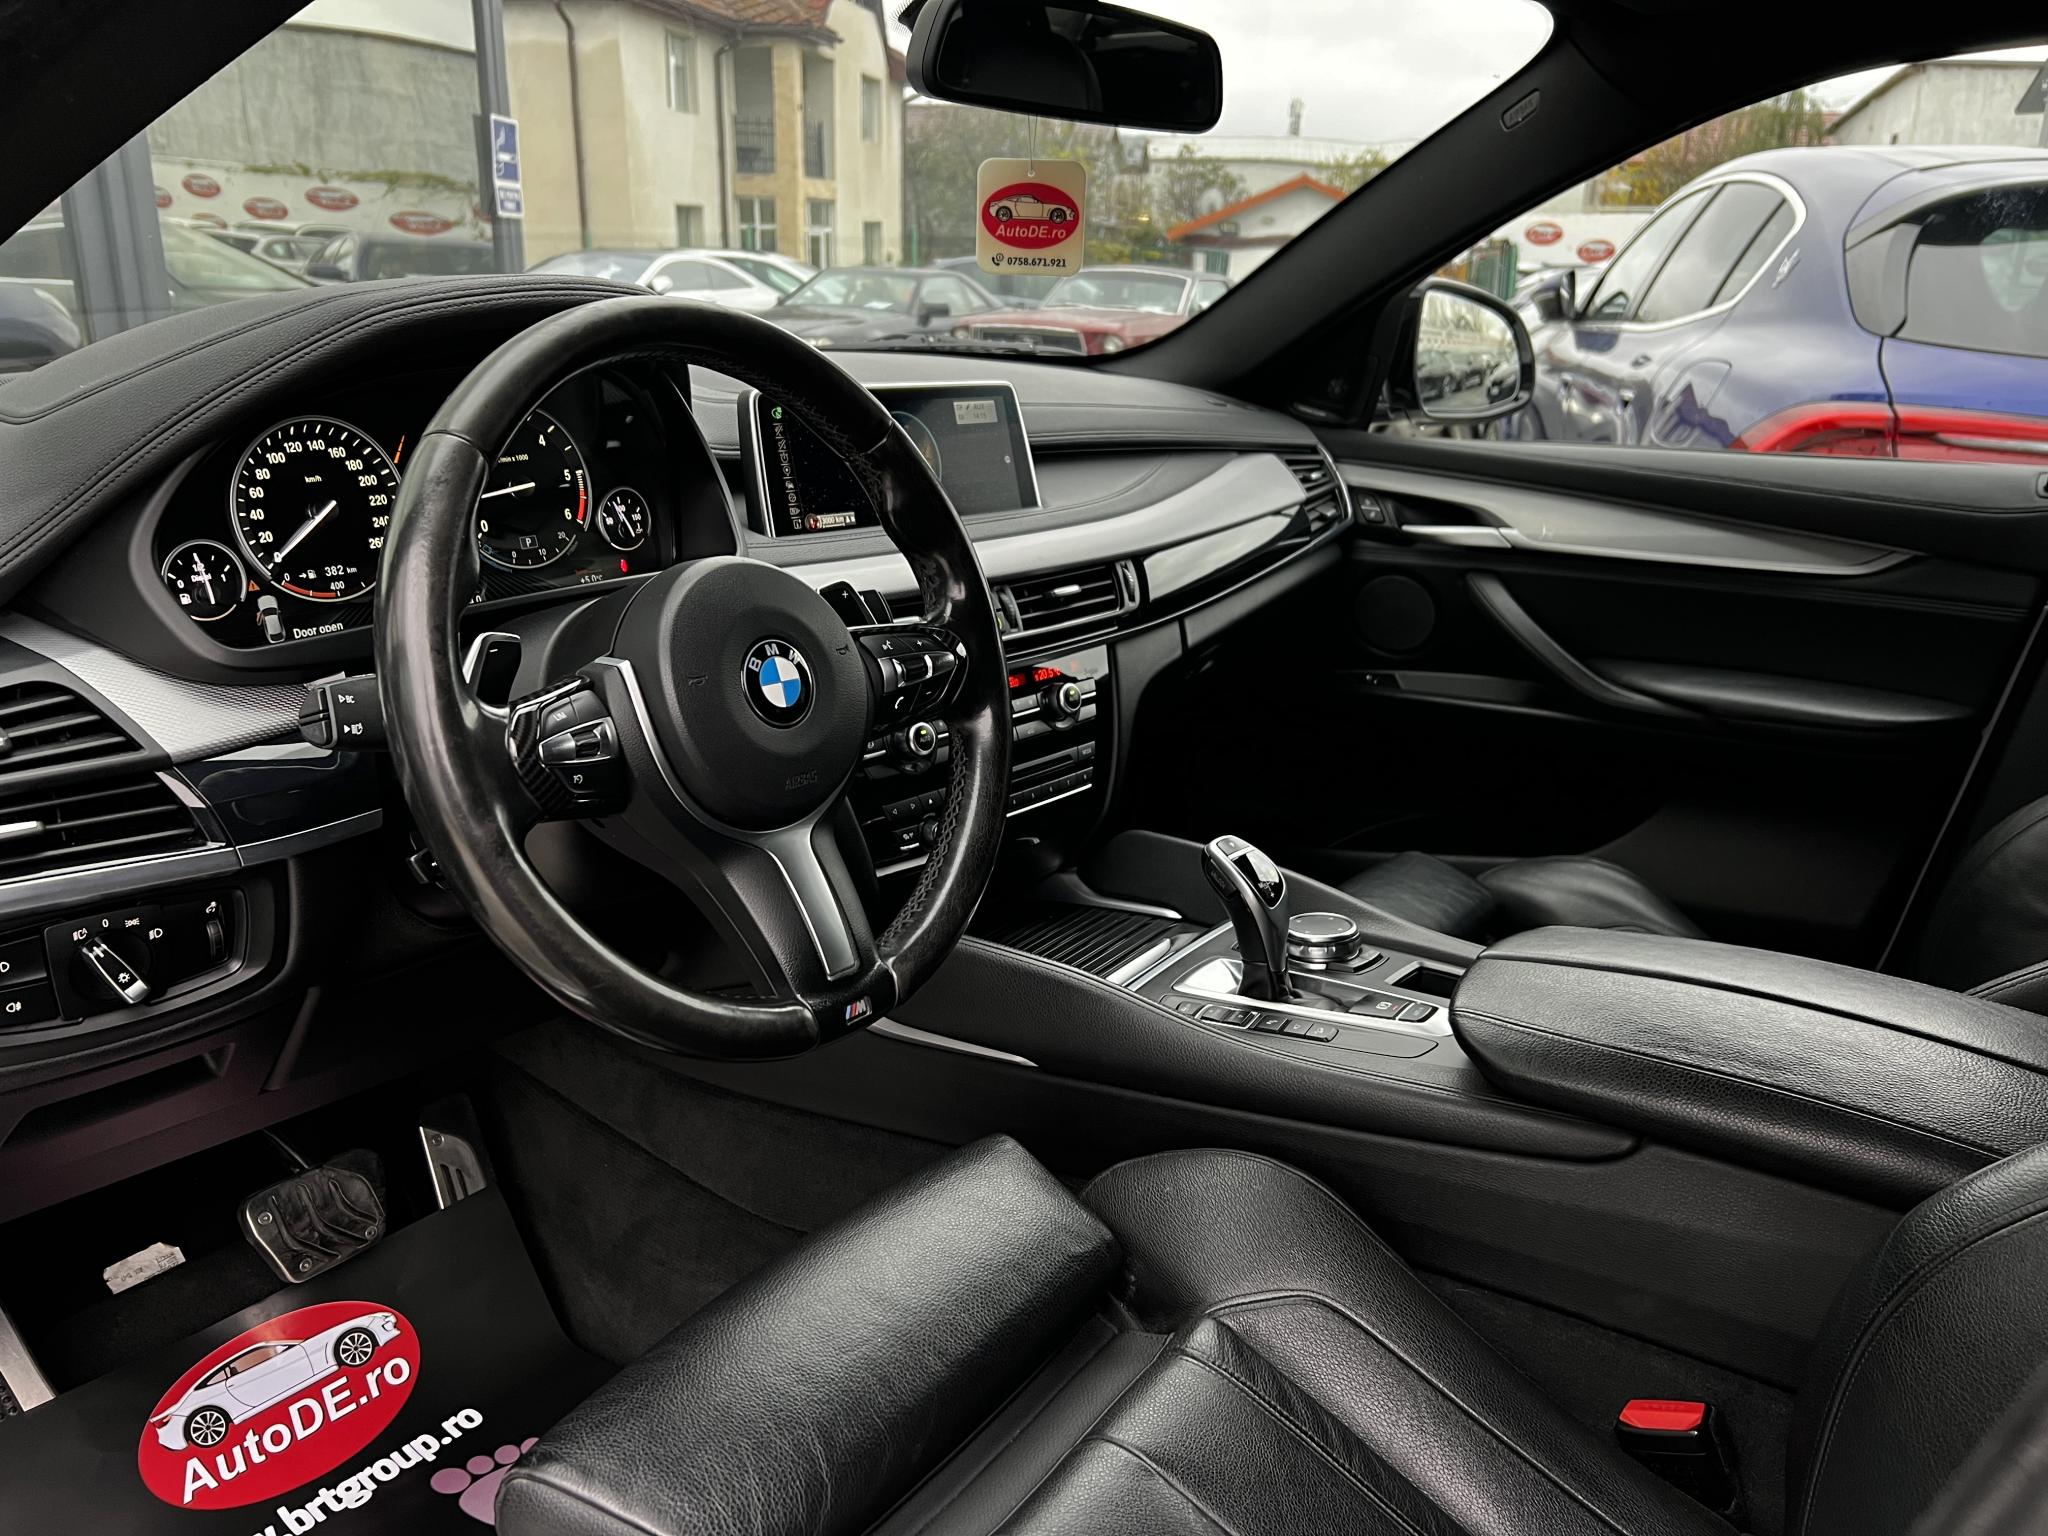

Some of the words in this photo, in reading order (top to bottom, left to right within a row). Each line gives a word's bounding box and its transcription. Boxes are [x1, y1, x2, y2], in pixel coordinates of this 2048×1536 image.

[995, 224, 1067, 239] AutoDE.ro
[1007, 256, 1067, 268] 0758.671.921
[306, 439, 326, 452] 140
[538, 434, 546, 447] 4
[283, 441, 303, 454] 120
[327, 446, 346, 459] 160
[265, 451, 286, 465] 100
[345, 459, 364, 472] 180
[254, 467, 271, 480] 80
[304, 474, 323, 484] km/h
[563, 468, 571, 481] 5
[358, 474, 378, 487] 200
[248, 486, 265, 499] 60
[368, 494, 388, 507] 220
[249, 508, 265, 521] 40
[564, 507, 572, 520] 6
[480, 519, 489, 533] 0
[258, 530, 274, 544] 20
[557, 531, 566, 540] 20
[511, 550, 517, 559] 0
[538, 548, 547, 557] 10
[283, 572, 291, 582] 0
[324, 564, 345, 577] 382
[346, 566, 358, 574] km
[176, 579, 185, 589] 0
[330, 580, 345, 591] 400
[293, 627, 318, 639] Door
[319, 622, 344, 634] open
[748, 643, 804, 673] BMW
[181, 1356, 411, 1505] AutoDE.ro
